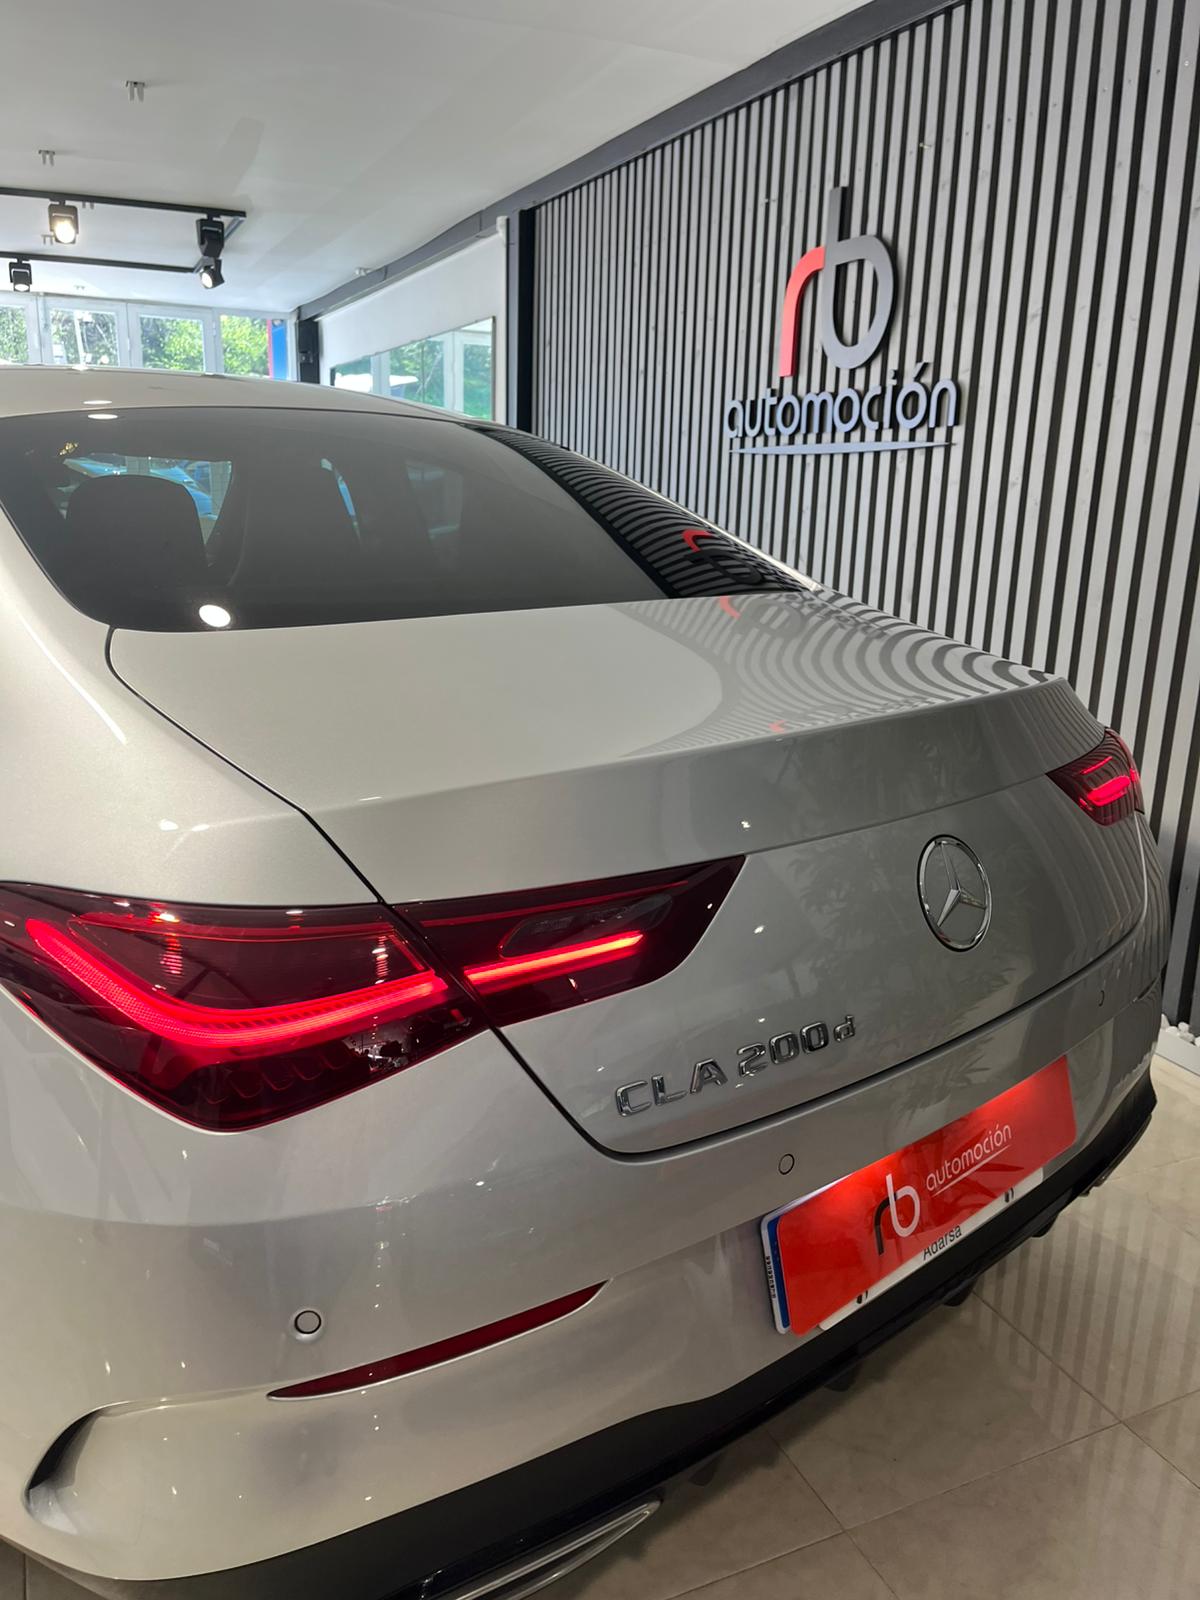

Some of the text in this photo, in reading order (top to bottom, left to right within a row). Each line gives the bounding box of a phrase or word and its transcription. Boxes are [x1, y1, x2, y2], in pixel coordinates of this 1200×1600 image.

[779, 186, 894, 377] rb
[724, 362, 958, 438] automoción
[615, 1015, 856, 1117] CLA 200 d
[926, 1124, 1012, 1192] automoción
[874, 1173, 921, 1256] rb
